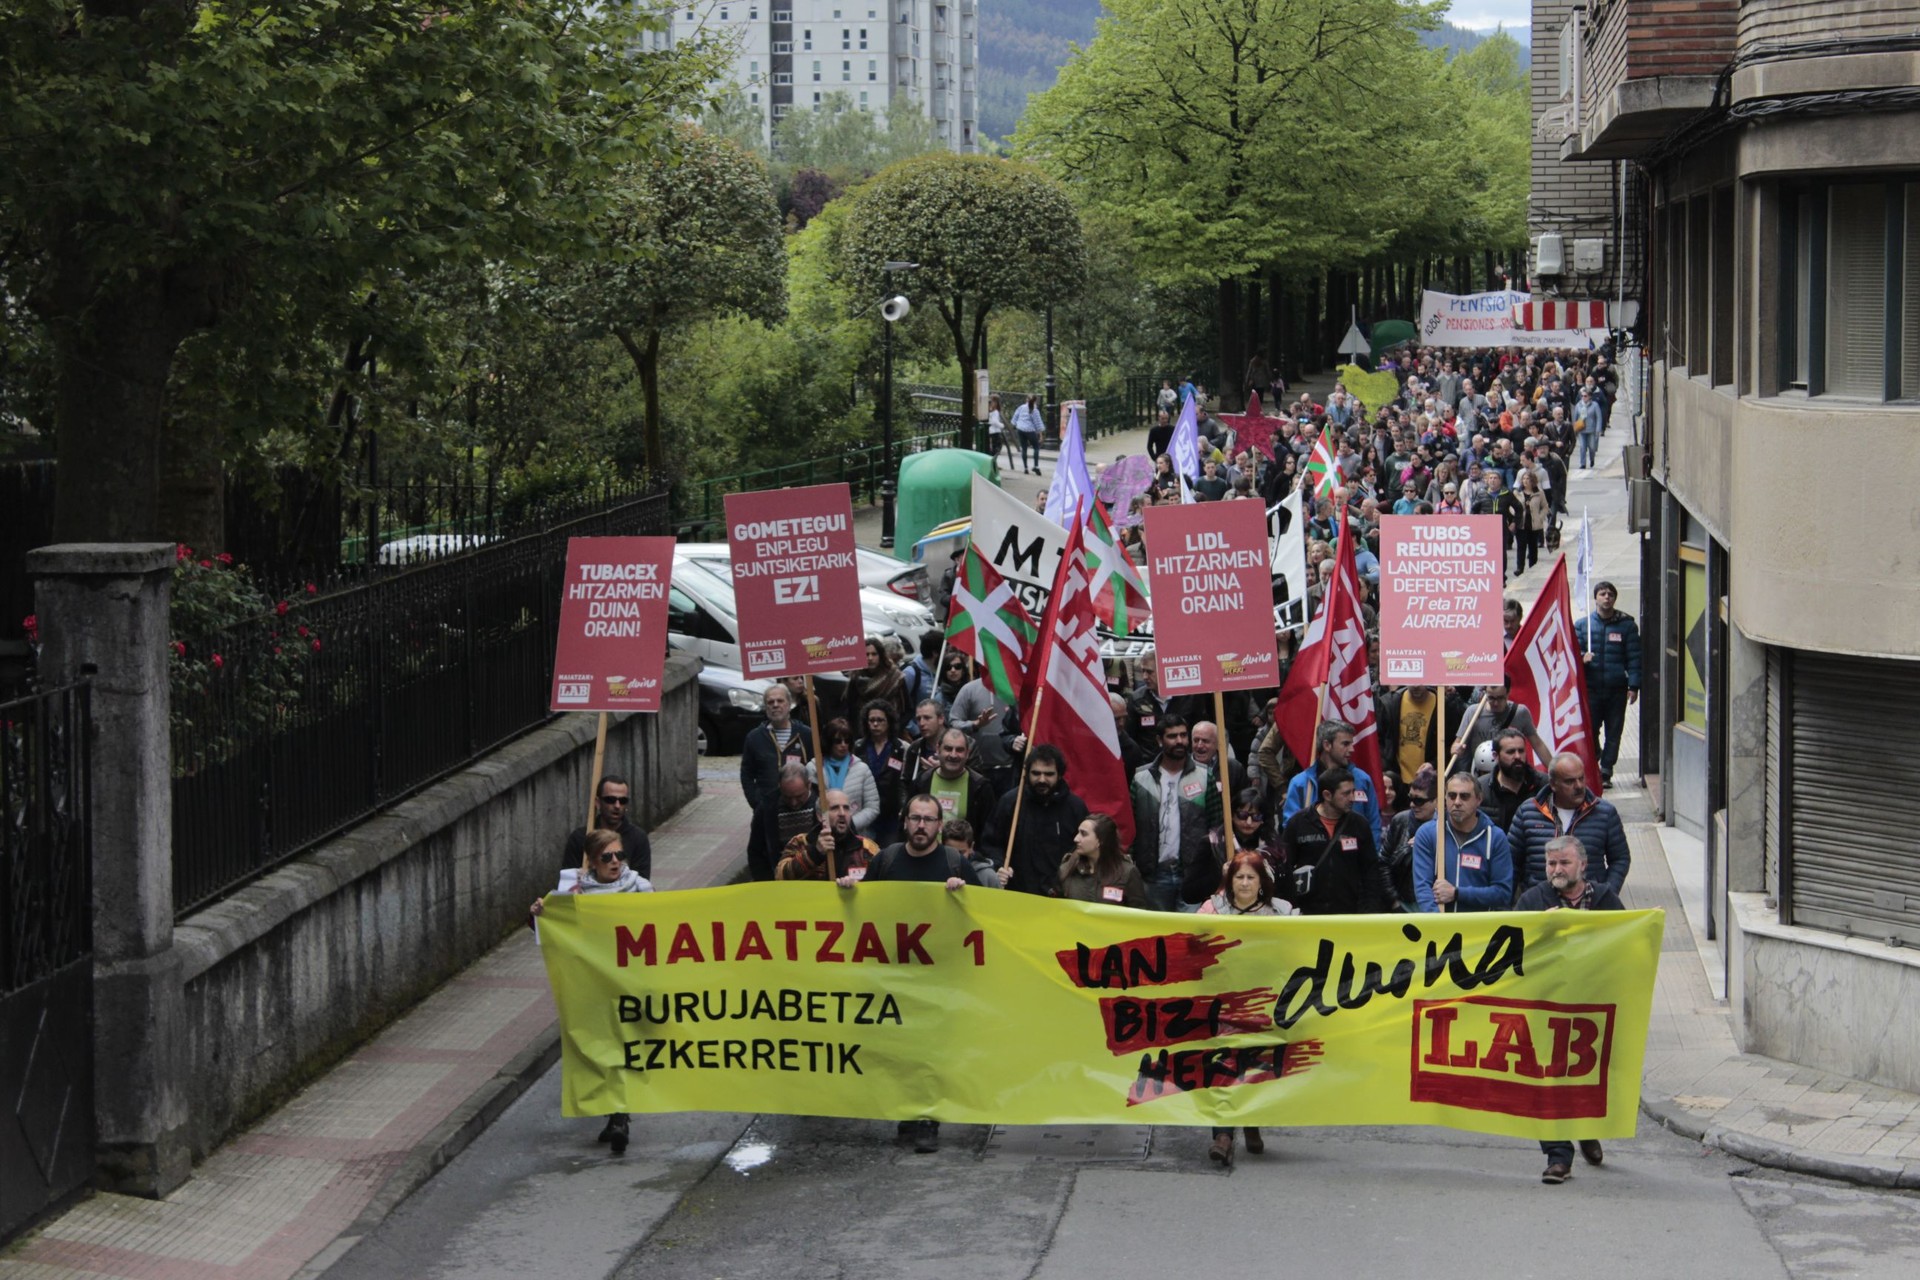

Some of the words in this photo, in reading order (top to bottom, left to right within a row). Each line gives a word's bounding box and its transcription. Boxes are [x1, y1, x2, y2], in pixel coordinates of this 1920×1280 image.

[734, 513, 847, 541] GOMETEGUI
[1411, 525, 1472, 540] TUBOS
[756, 536, 829, 558] ENPLEGU
[1185, 532, 1231, 552] LIDL
[1396, 542, 1488, 557] REUNIDOS
[580, 564, 659, 581] TUBACEX
[734, 552, 855, 578] SUNTSIKETARIK
[1155, 549, 1263, 575] HITZARMEN
[1387, 560, 1496, 575] LANPOSTUEN
[569, 583, 664, 599] HITZARMEN
[773, 575, 820, 605] EZ!
[1182, 572, 1242, 594] DUINA
[1393, 578, 1490, 593] DEFENTSAN
[589, 602, 641, 618] DUINA
[1181, 592, 1244, 615] ORAIN!
[1406, 596, 1428, 611] PT
[1428, 597, 1451, 611] eta
[1454, 596, 1478, 611] TRI
[584, 621, 641, 637] ORAIN!
[1402, 614, 1482, 629] AURRERA!
[751, 651, 784, 665] LAB
[1391, 660, 1421, 672] LAB
[1167, 666, 1199, 681] LAB
[560, 685, 588, 697] LAB
[615, 919, 934, 968] MAIATZAK
[963, 929, 986, 967] 1
[1074, 936, 1168, 990] LAN
[1273, 921, 1526, 1030] duina
[619, 989, 903, 1026] BURUJABETZA
[1112, 996, 1221, 1043] BIZI
[1423, 1006, 1600, 1079] LAB
[624, 1038, 864, 1075] EZKERRETIK
[1134, 1042, 1286, 1099] HERRI
